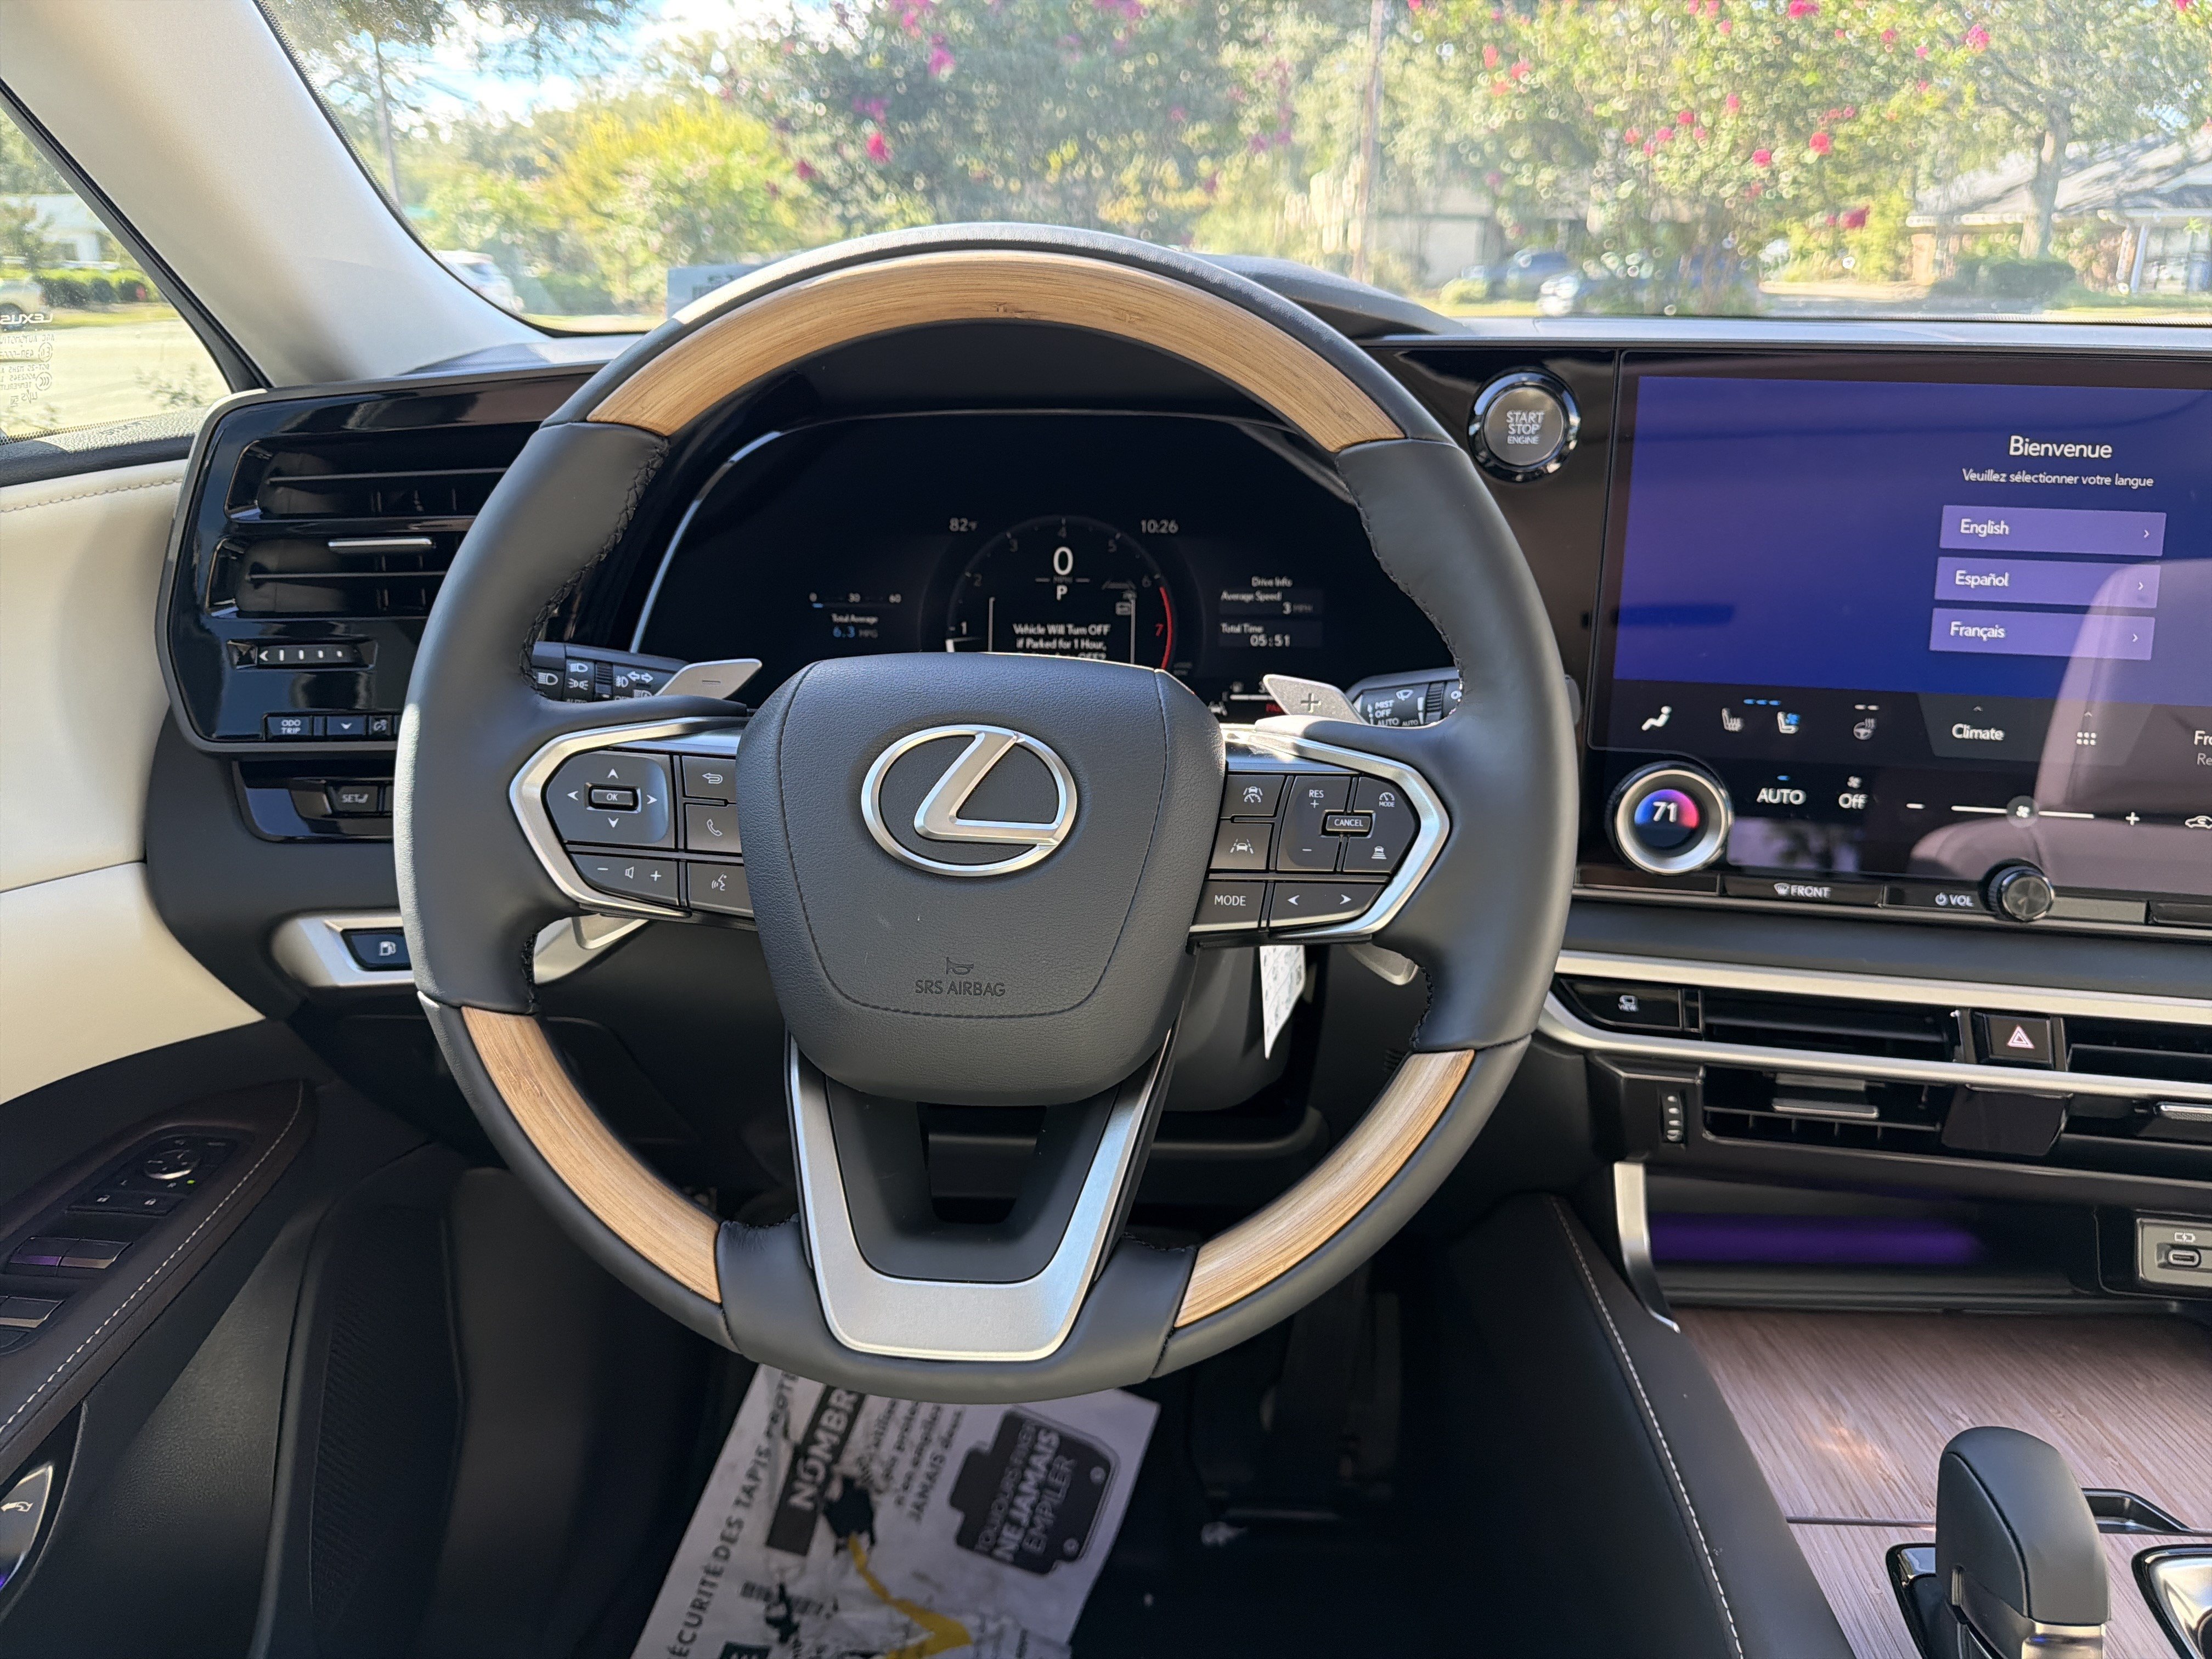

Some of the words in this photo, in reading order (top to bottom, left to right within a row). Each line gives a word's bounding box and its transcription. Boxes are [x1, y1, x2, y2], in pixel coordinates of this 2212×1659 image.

[1506, 410, 1545, 424] START
[1508, 424, 1542, 436] STOP
[1507, 436, 1539, 445] ENGINE
[2008, 435, 2113, 459] Bienvenue
[1962, 468, 2007, 483] Veuillez
[2009, 469, 2079, 486] sélectionner
[2081, 474, 2112, 487] votre
[2114, 473, 2154, 489] langue
[1141, 519, 1179, 534] 10:26
[1960, 518, 2010, 538] English
[1053, 546, 1073, 575] 0
[1251, 576, 1274, 587] Drive
[1275, 576, 1293, 587] Info
[1955, 569, 2009, 589] Español
[1057, 585, 1068, 601] P
[1047, 624, 1065, 635] Will
[1088, 624, 1111, 635] OFF
[1155, 623, 1163, 637] 7
[1950, 622, 2005, 641] Français
[1026, 637, 1057, 649] Parked
[1250, 634, 1290, 647] 05:51
[1375, 708, 1392, 718] OFF
[1378, 717, 1400, 726] AUTO
[1951, 723, 2005, 742] Climate
[607, 793, 618, 802] OK
[1308, 789, 1324, 798] RES
[1756, 788, 1807, 806] AUTO
[1838, 793, 1868, 810] Off
[1652, 802, 1677, 823] 71
[1334, 819, 1363, 827] CANCEL
[1790, 886, 1832, 898] FRONT
[1214, 894, 1246, 906] MODE
[1949, 894, 1974, 907] VOL
[915, 979, 943, 994] SRS
[947, 980, 1006, 997] AIRBAG
[1006, 1426, 1061, 1527] JAMAIS
[711, 1515, 745, 1563] DES
[733, 1444, 772, 1509] TAPIS
[1022, 1453, 1077, 1555] EMPILER
[992, 1520, 1026, 1562] NE
